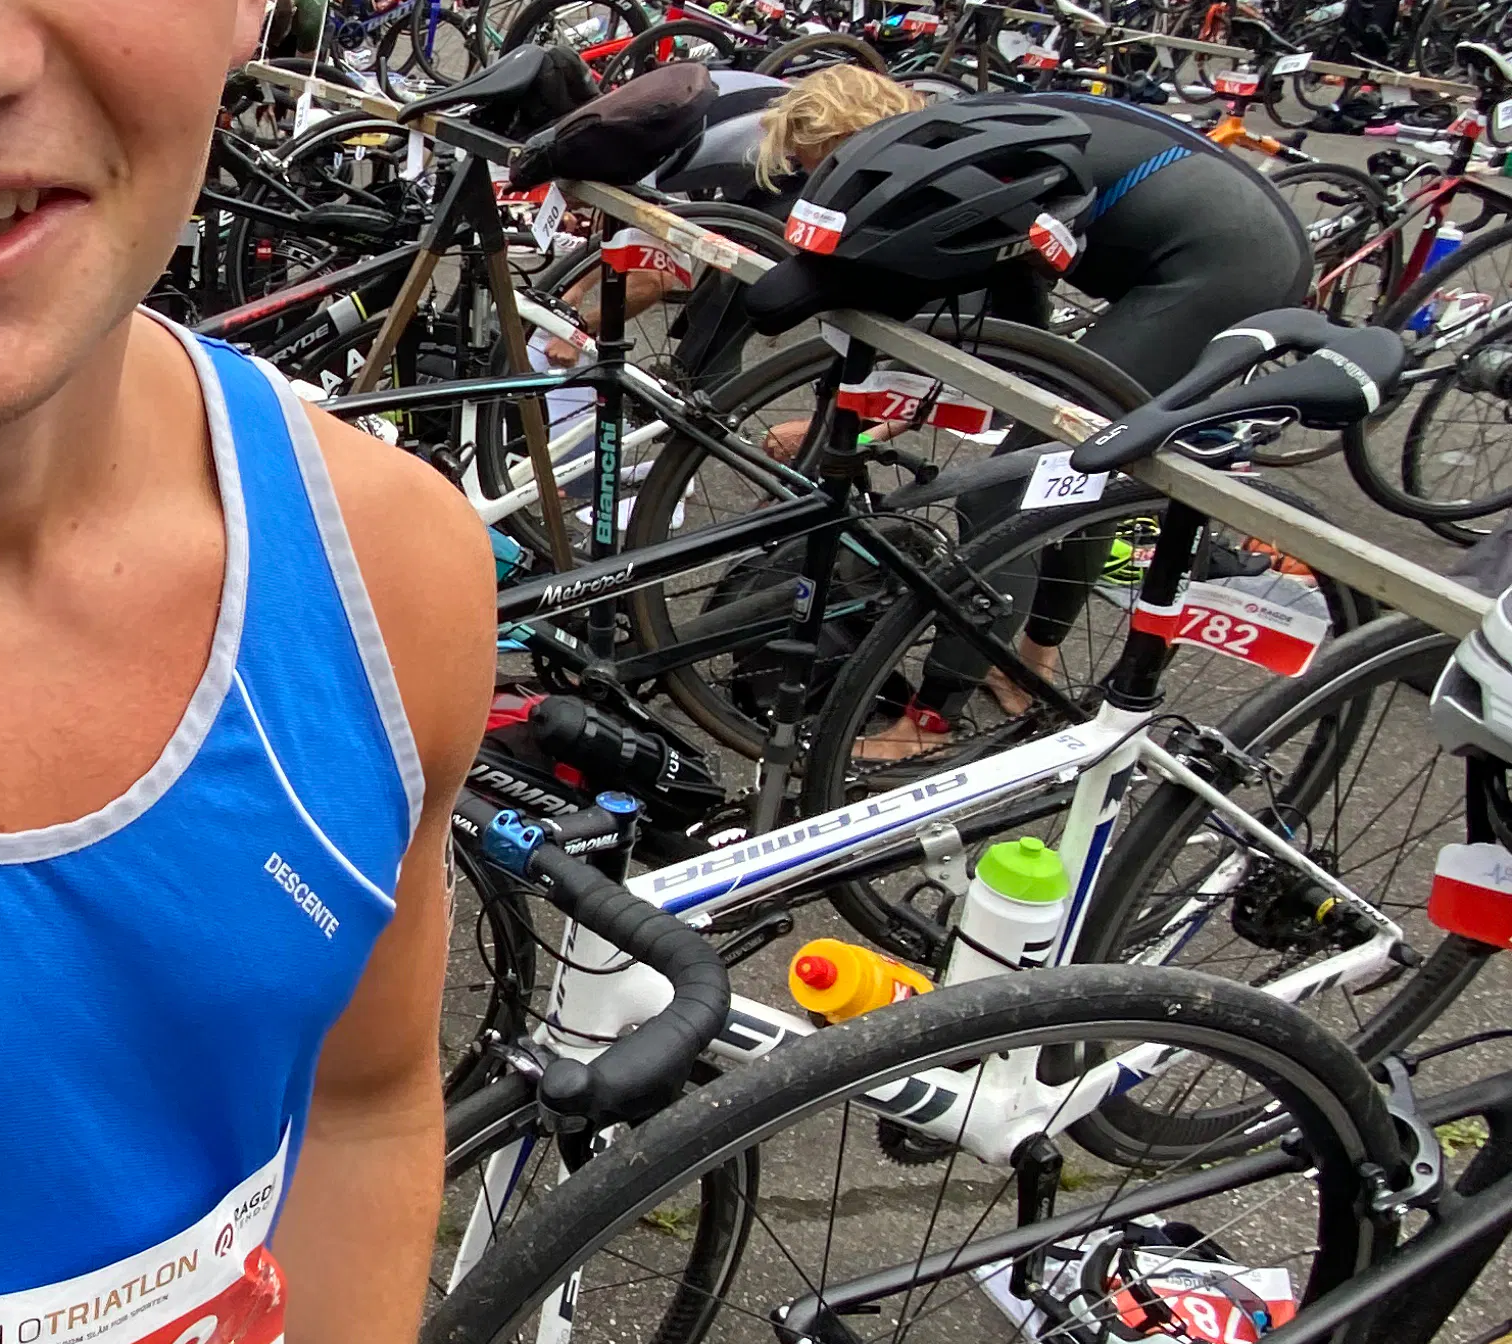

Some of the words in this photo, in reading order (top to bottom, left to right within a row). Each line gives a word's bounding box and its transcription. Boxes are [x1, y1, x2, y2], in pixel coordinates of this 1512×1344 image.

[541, 206, 561, 237] 780
[596, 421, 618, 545] Bianchi
[1043, 473, 1089, 499] 782
[538, 562, 635, 609] Metropol
[1179, 608, 1259, 655] 782
[653, 772, 969, 894] ALTAMIRA
[263, 851, 341, 941] DESCENTE
